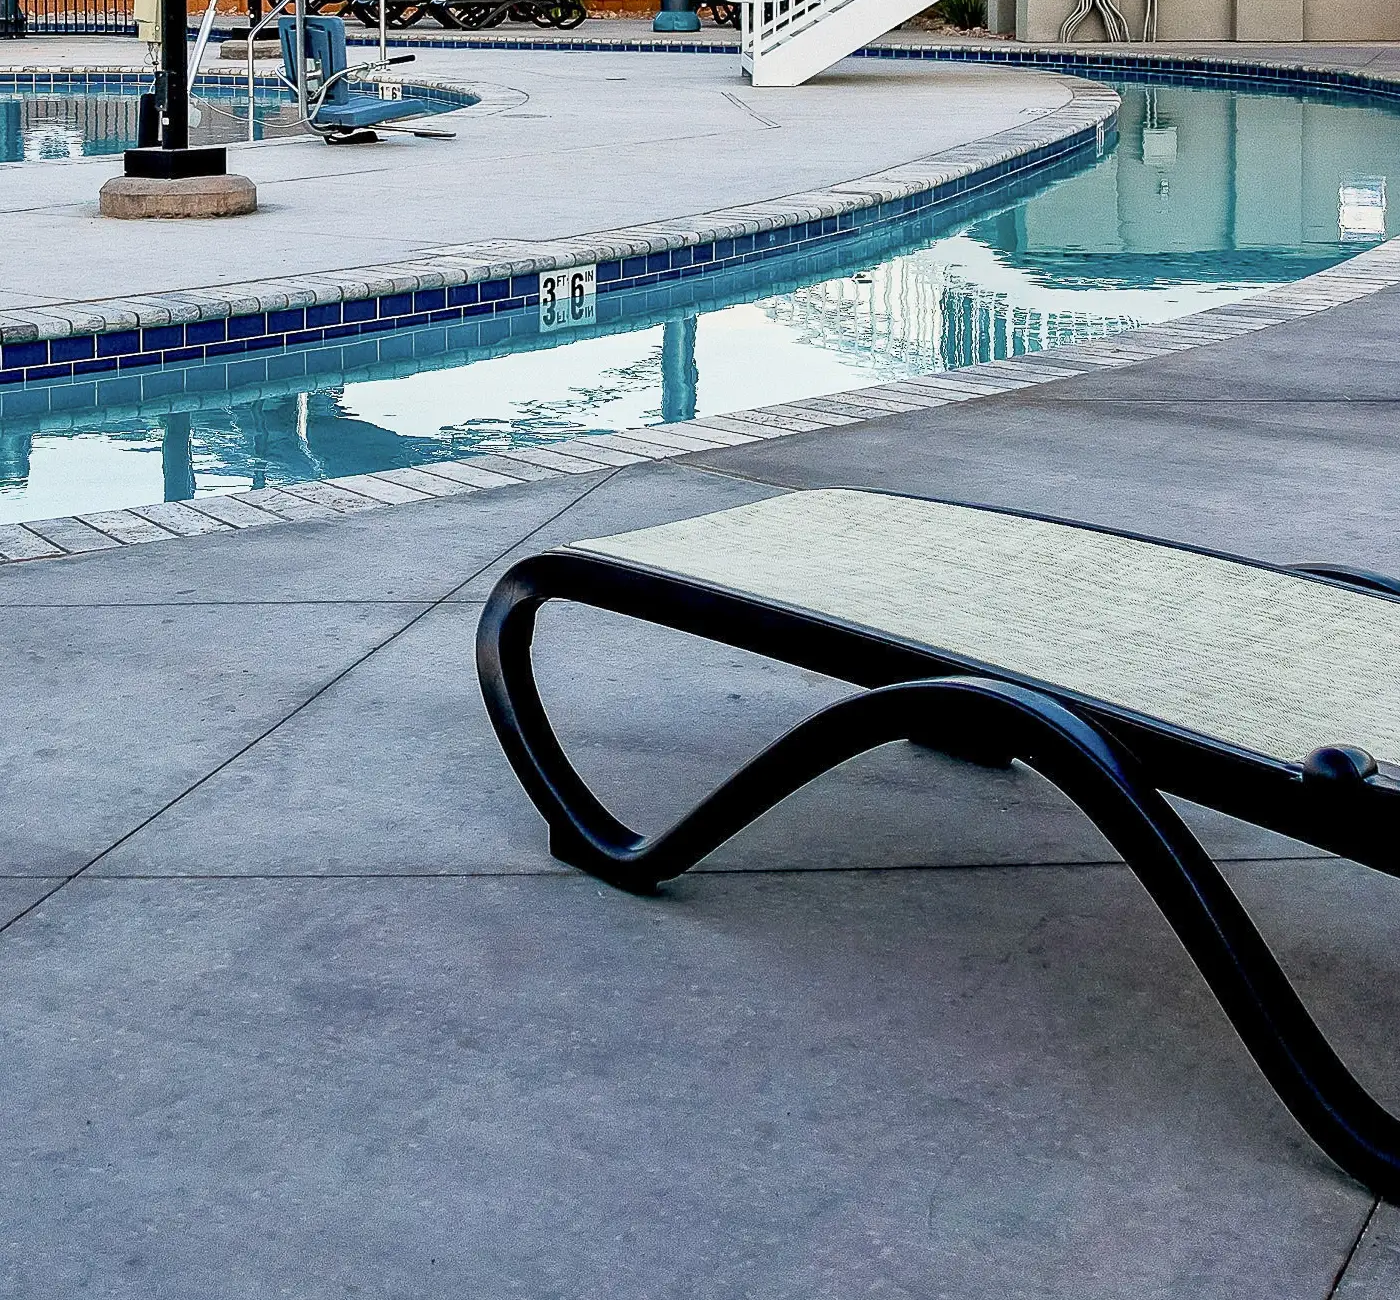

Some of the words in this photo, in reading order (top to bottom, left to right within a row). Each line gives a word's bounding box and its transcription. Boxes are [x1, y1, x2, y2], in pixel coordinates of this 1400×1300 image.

[380, 86, 384, 99] 1
[392, 87, 397, 99] 6
[543, 277, 556, 303] 3
[557, 275, 566, 287] FT
[571, 273, 584, 298] 6
[585, 270, 594, 282] IN
